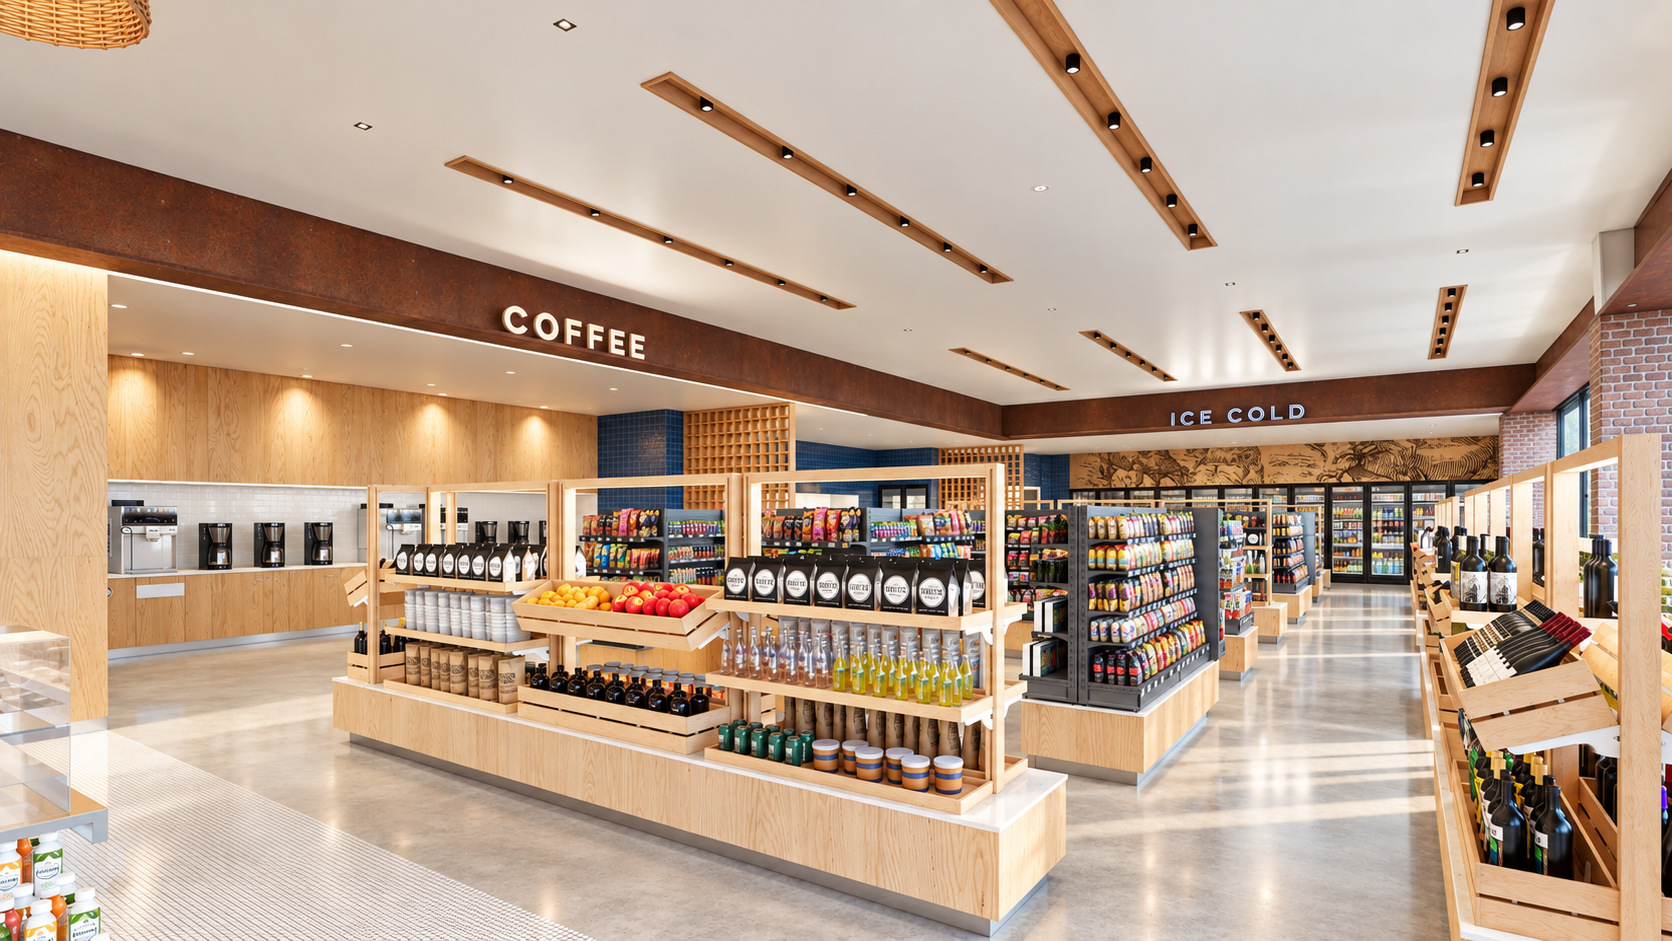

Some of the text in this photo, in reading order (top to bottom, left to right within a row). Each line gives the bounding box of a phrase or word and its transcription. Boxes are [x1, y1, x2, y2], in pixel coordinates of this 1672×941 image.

[502, 305, 646, 360] COFFEE
[1170, 404, 1306, 427] ICE COLD
